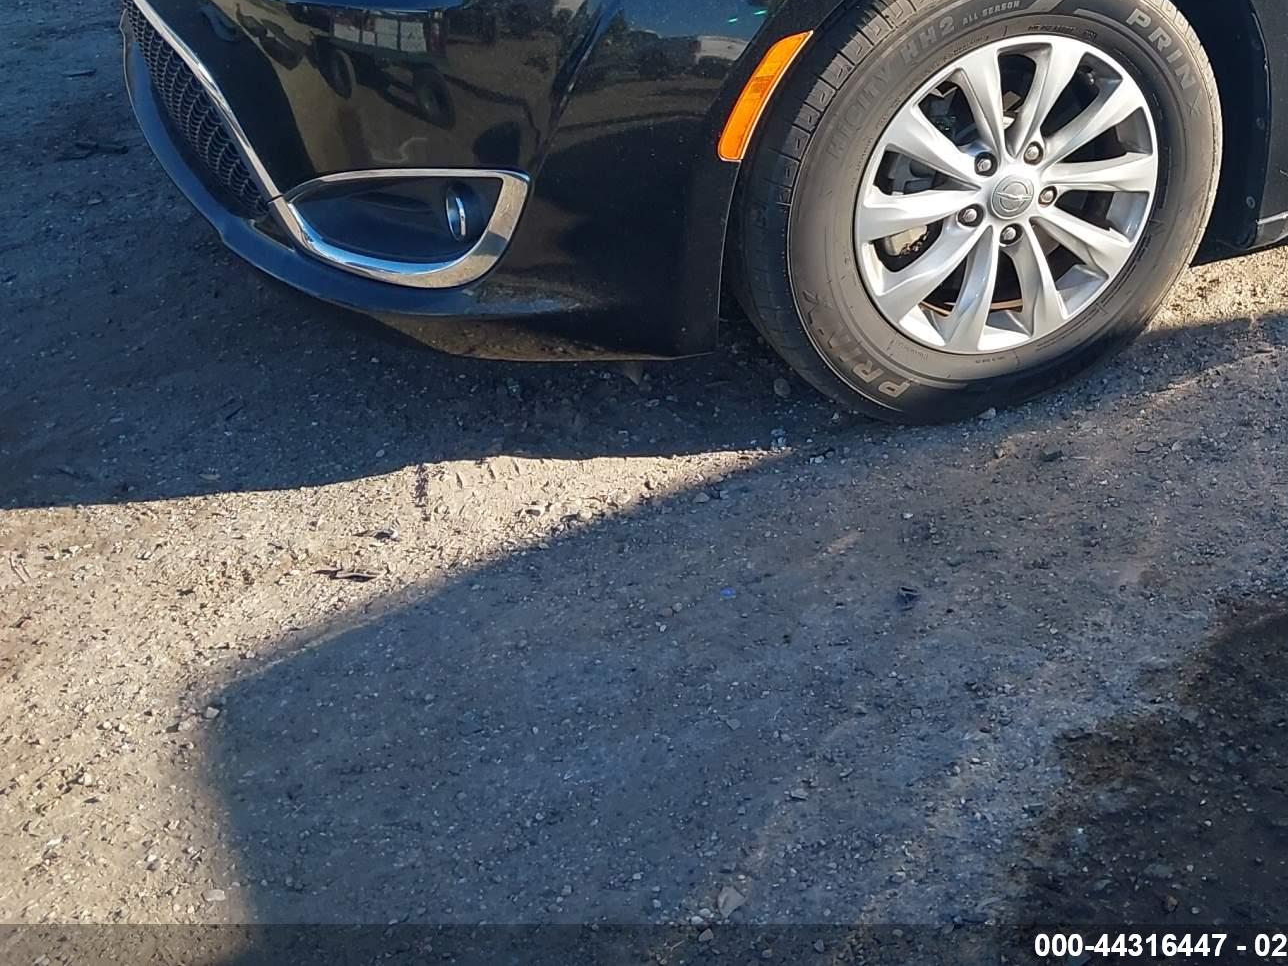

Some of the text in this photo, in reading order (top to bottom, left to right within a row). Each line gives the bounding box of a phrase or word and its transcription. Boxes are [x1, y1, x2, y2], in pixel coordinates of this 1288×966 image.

[900, 15, 956, 65] HH2
[962, 13, 979, 26] ALL
[982, 0, 1021, 17] SEASON
[1125, 7, 1203, 119] PRINX
